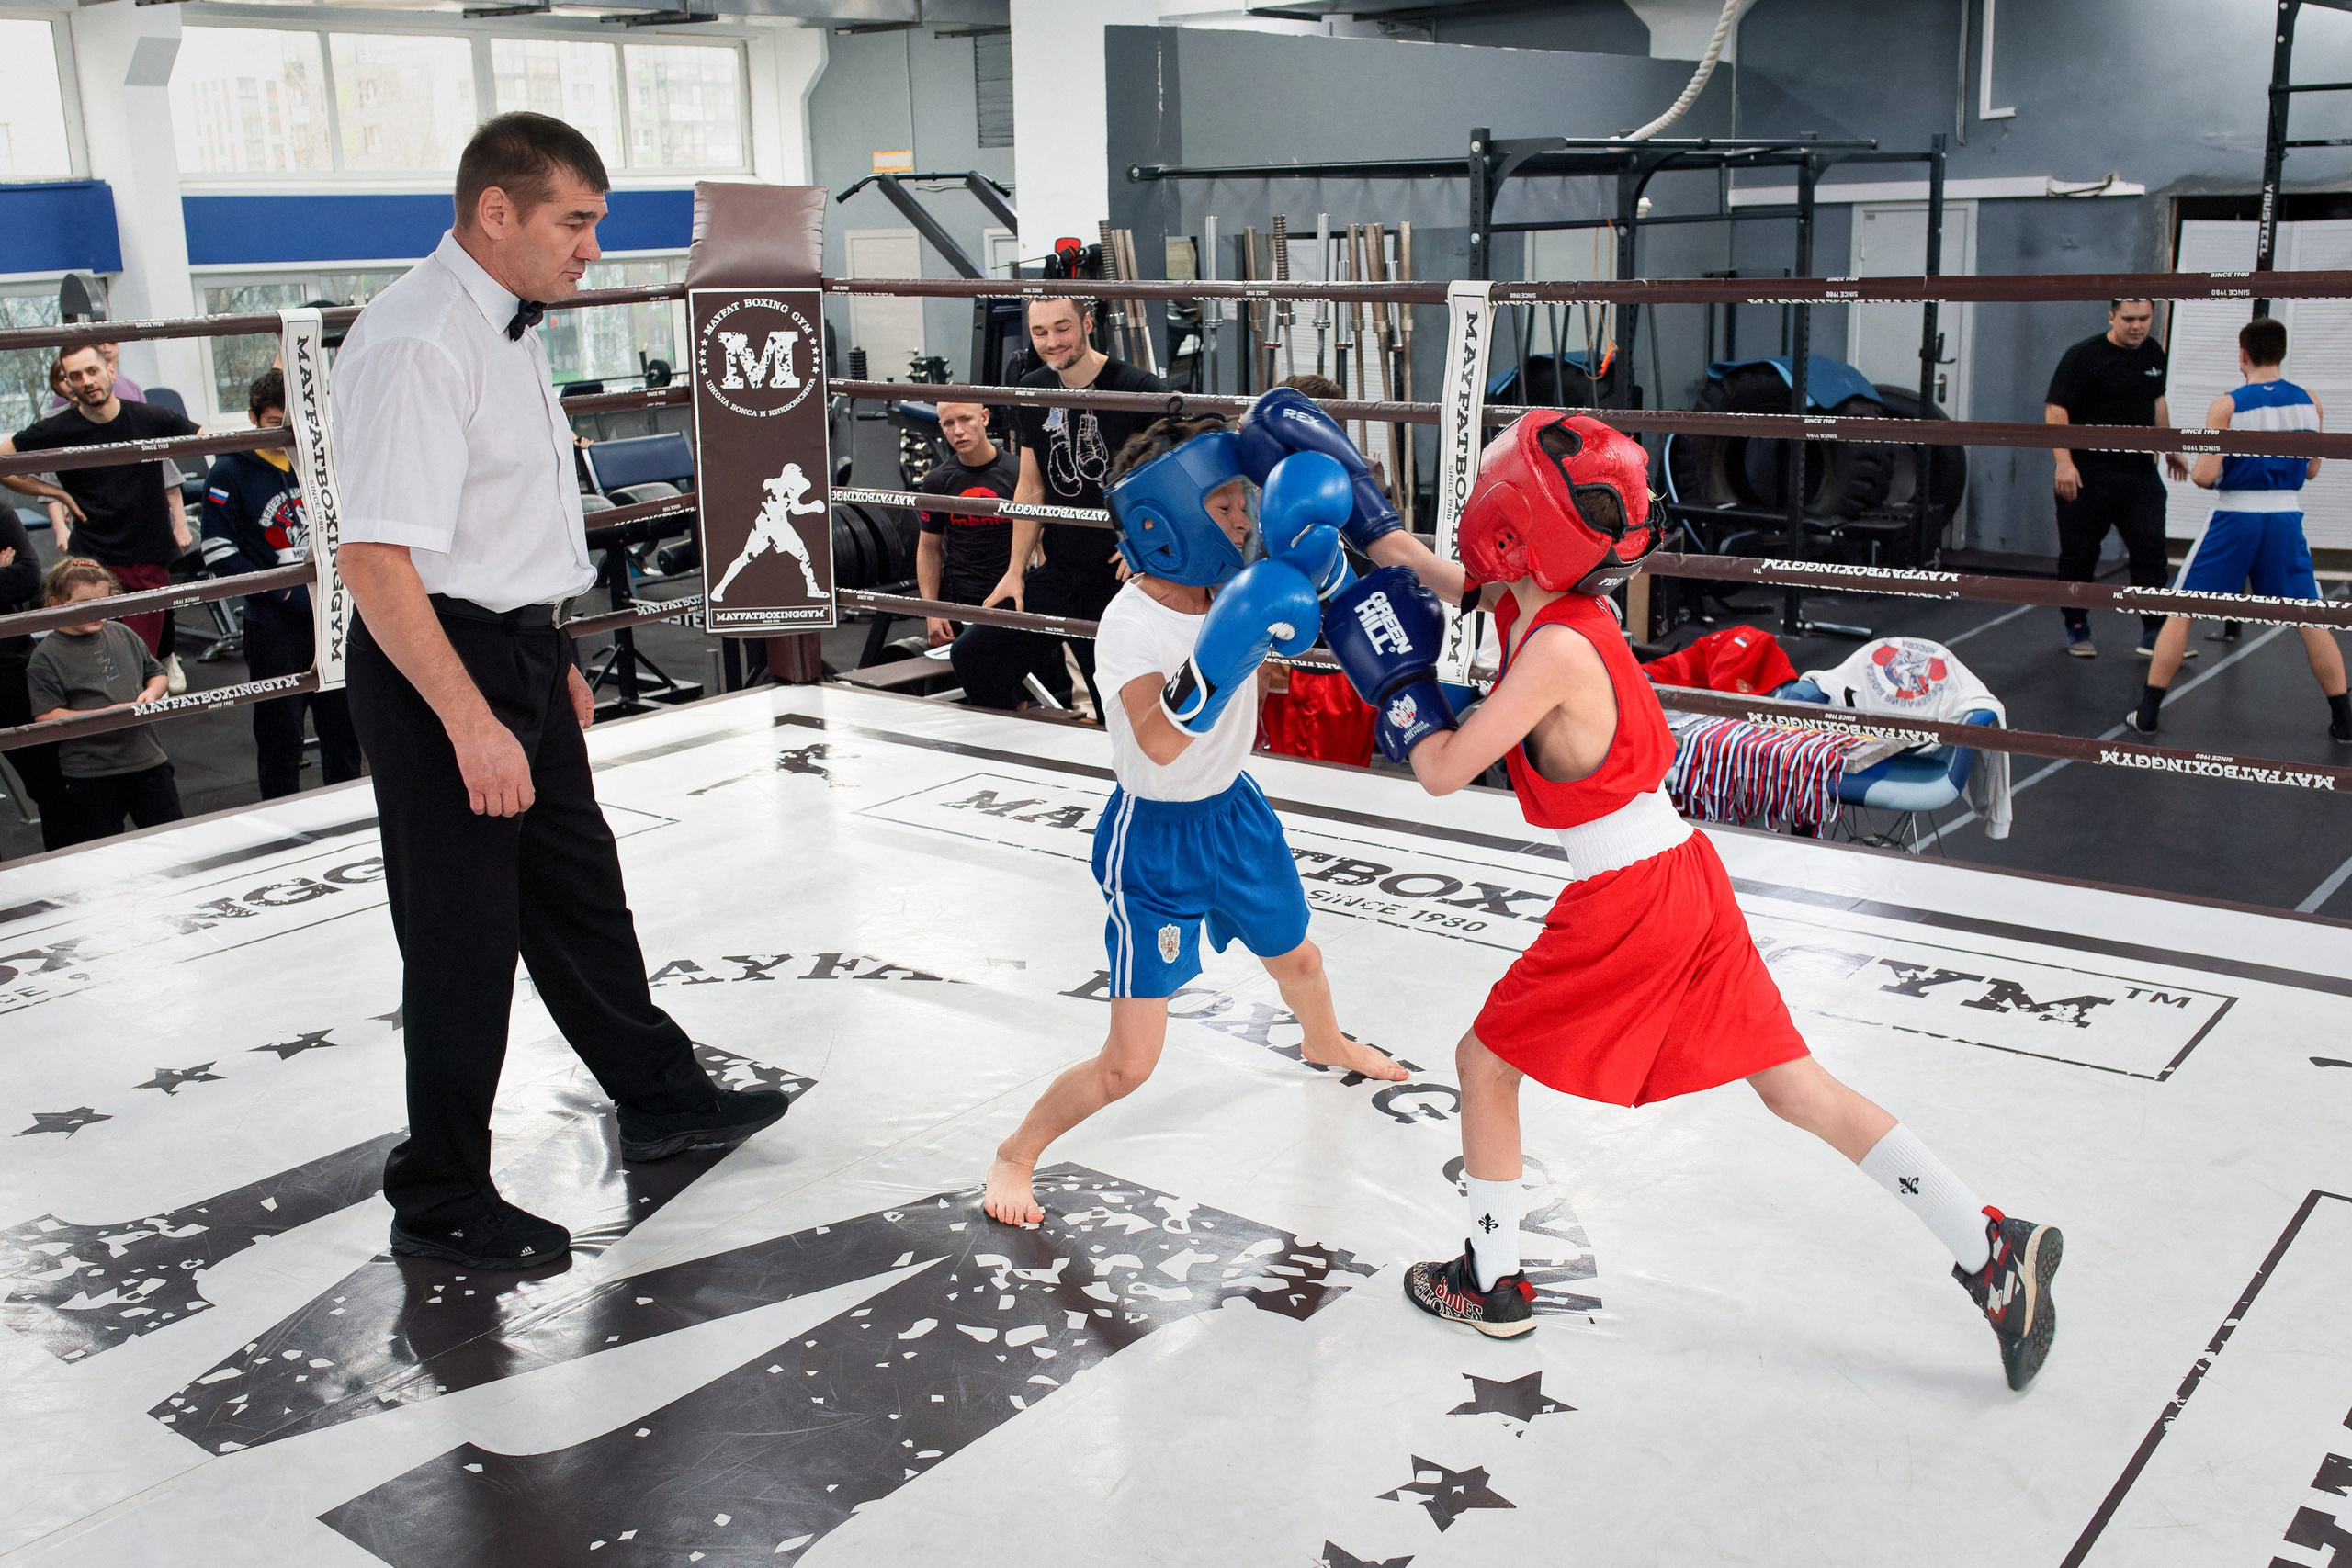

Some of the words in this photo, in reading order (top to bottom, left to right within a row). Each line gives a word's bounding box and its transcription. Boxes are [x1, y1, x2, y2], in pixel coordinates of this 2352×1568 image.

[703, 301, 740, 337] MAYFAT
[743, 298, 789, 314] BOXING
[791, 311, 814, 335] GYM
[309, 479, 321, 510] SINCE
[1598, 577, 1624, 586] PRO
[716, 609, 825, 622] MAYFATBOXINGGYM
[1353, 598, 1385, 656] HILL
[1369, 591, 1414, 655] GREEN
[130, 674, 300, 716] MAYFATBOXINGGYM
[1747, 711, 1940, 744] MAYFATBOXINGGYM
[2099, 750, 2335, 791] MAYFATBOXINGGYM
[1306, 888, 1409, 916] SINCE
[1408, 909, 1489, 932] 1980
